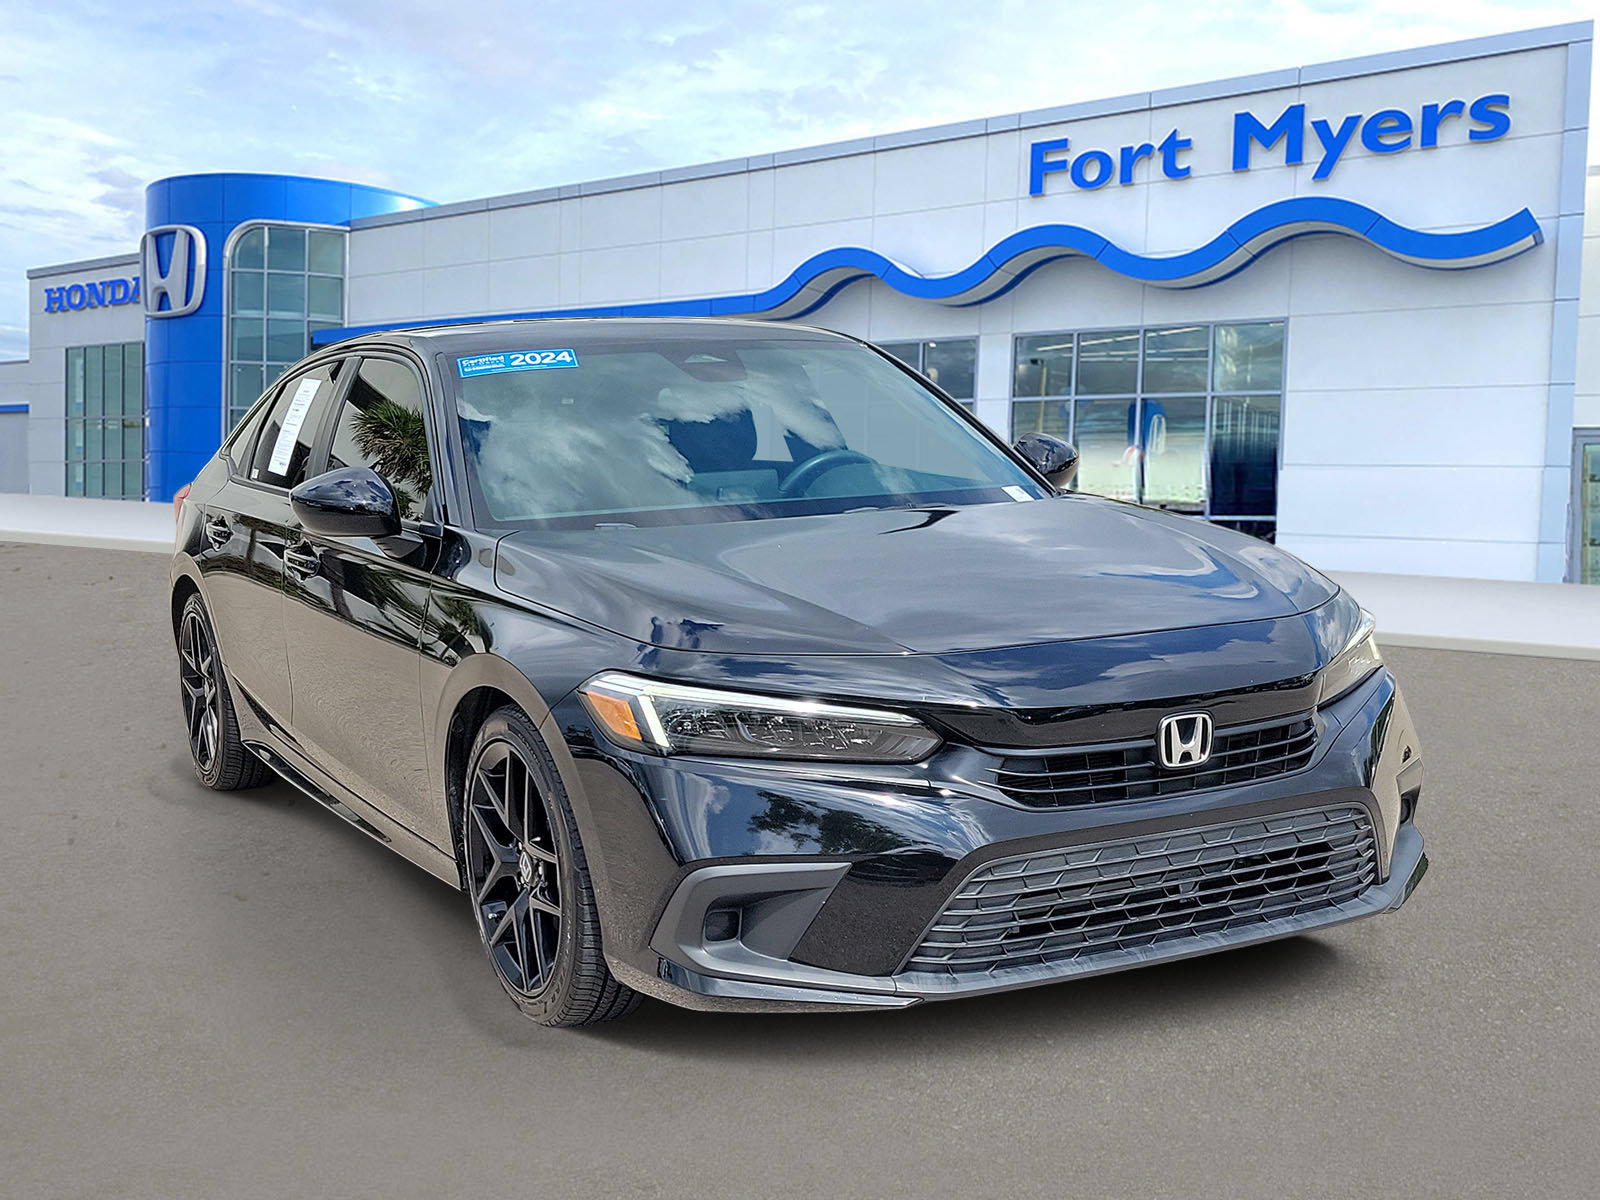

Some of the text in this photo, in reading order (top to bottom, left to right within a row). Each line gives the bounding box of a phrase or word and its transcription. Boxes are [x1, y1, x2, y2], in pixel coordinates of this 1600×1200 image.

[1029, 94, 1511, 196] Fort Myers
[509, 351, 573, 366] 2024
